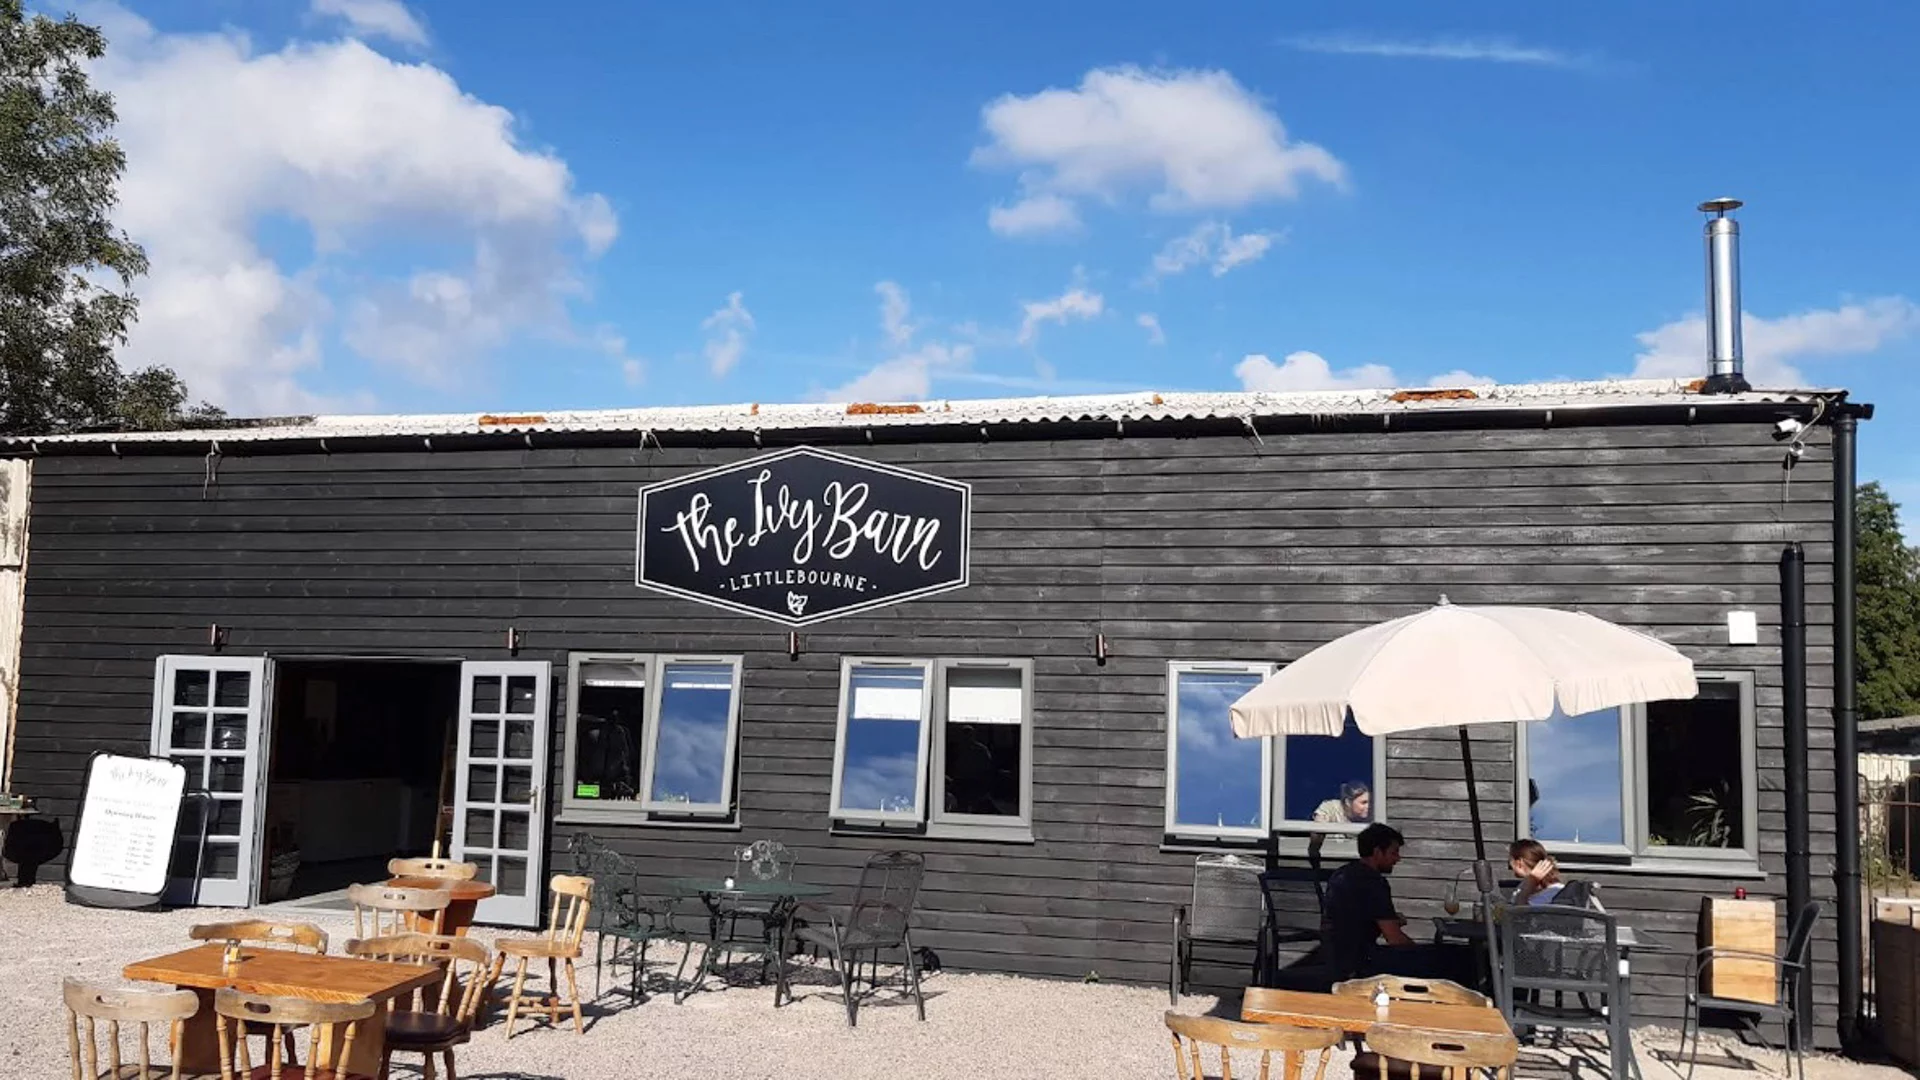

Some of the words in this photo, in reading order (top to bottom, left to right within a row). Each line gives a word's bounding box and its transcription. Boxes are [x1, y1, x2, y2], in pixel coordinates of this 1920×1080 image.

[747, 469, 822, 564] Ivy
[822, 482, 942, 570] Barn
[730, 570, 867, 591] LITTLEBOURNE
